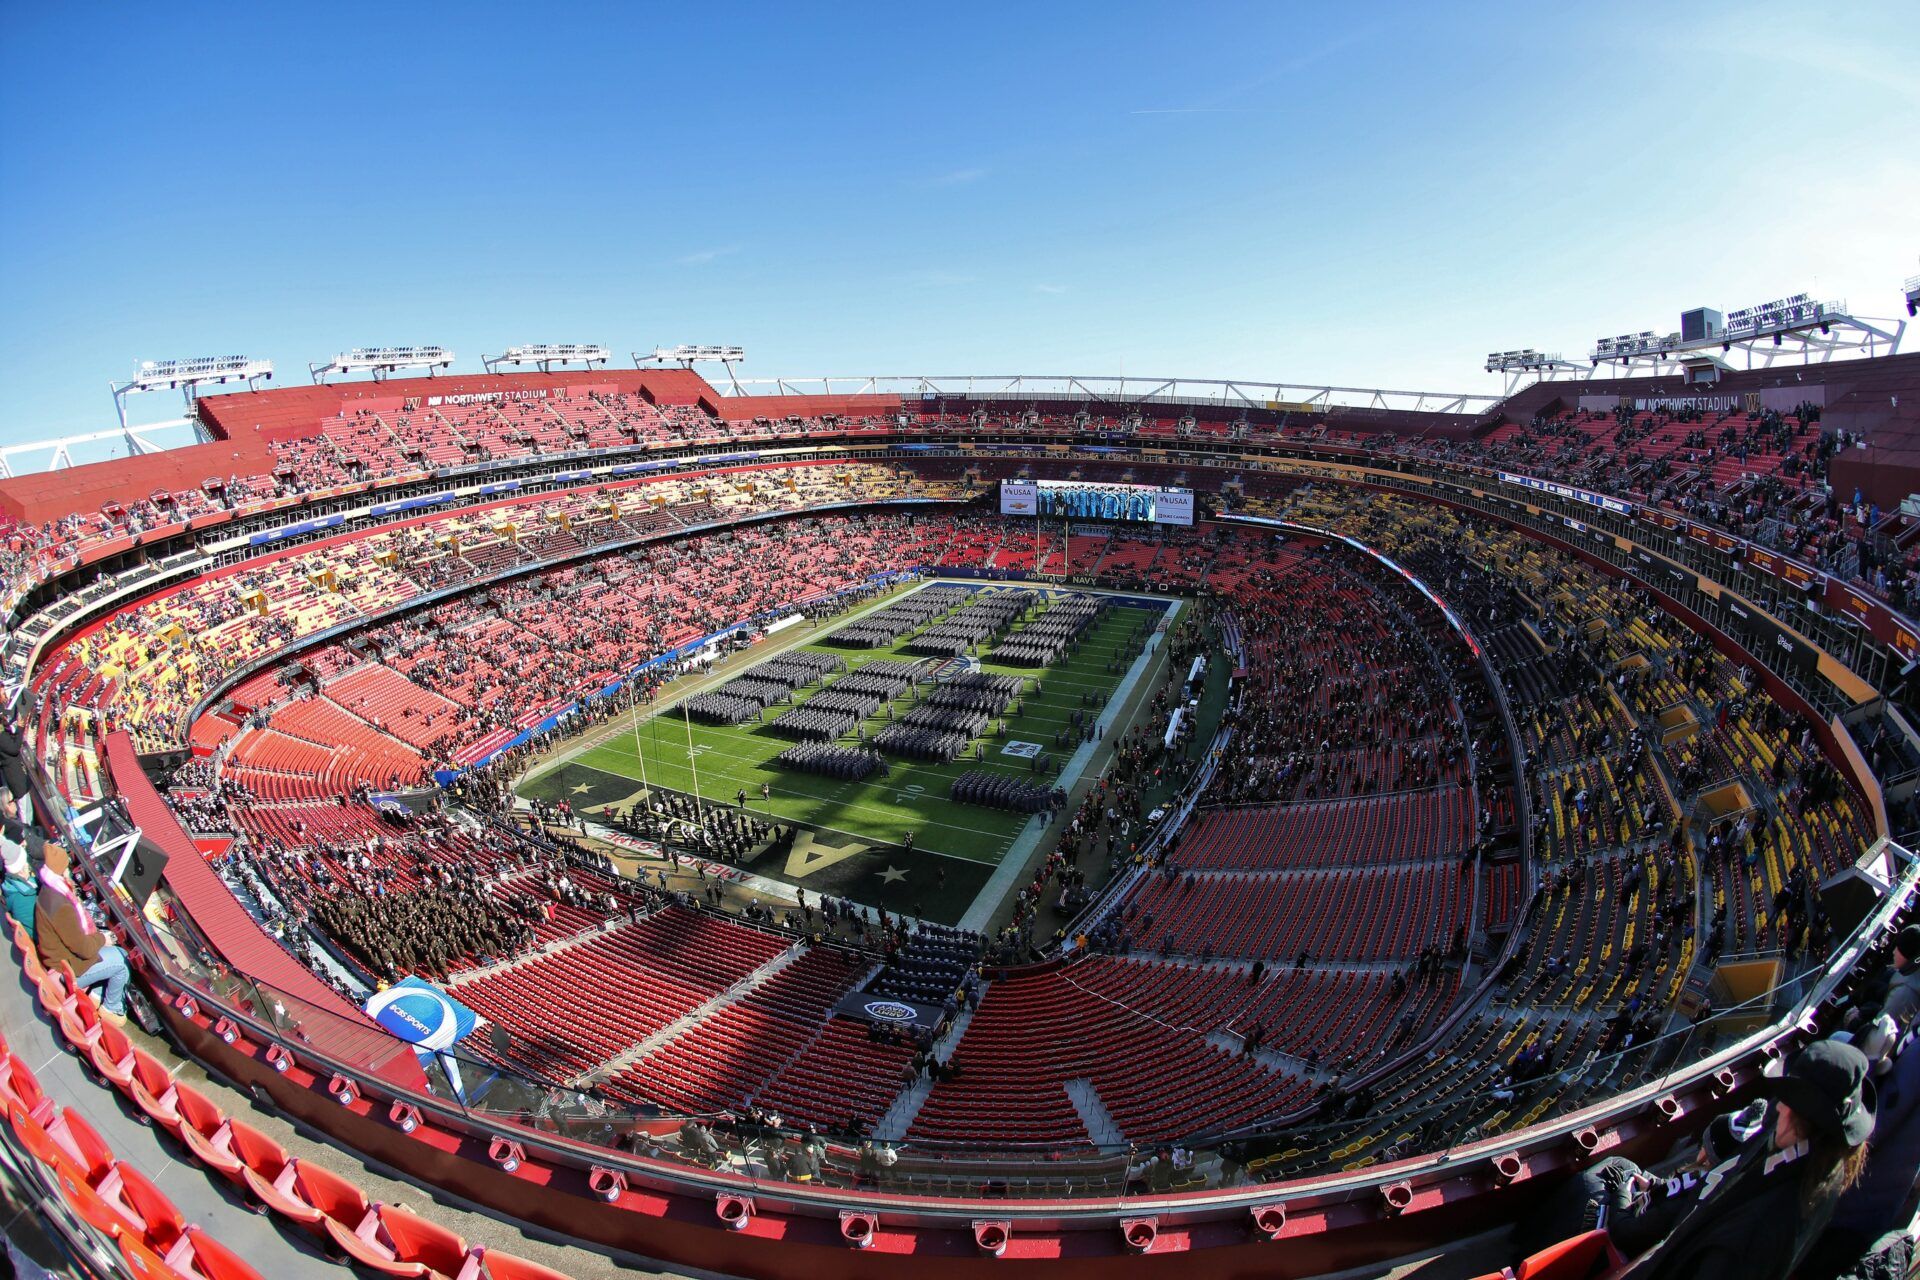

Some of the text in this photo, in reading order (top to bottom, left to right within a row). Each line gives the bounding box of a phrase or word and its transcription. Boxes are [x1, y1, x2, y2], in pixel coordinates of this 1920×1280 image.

[445, 392, 503, 404] NORTHWEST
[505, 390, 547, 400] STADIUM
[1648, 398, 1696, 411] NORTHWEST
[1698, 396, 1738, 411] STADIUM
[1013, 488, 1032, 496] USAA
[1169, 497, 1188, 505] USAA
[1024, 572, 1048, 581] ARMY
[1072, 576, 1097, 586] NAVY
[604, 832, 654, 851] GAME
[394, 1006, 431, 1035] CBS SPORTS
